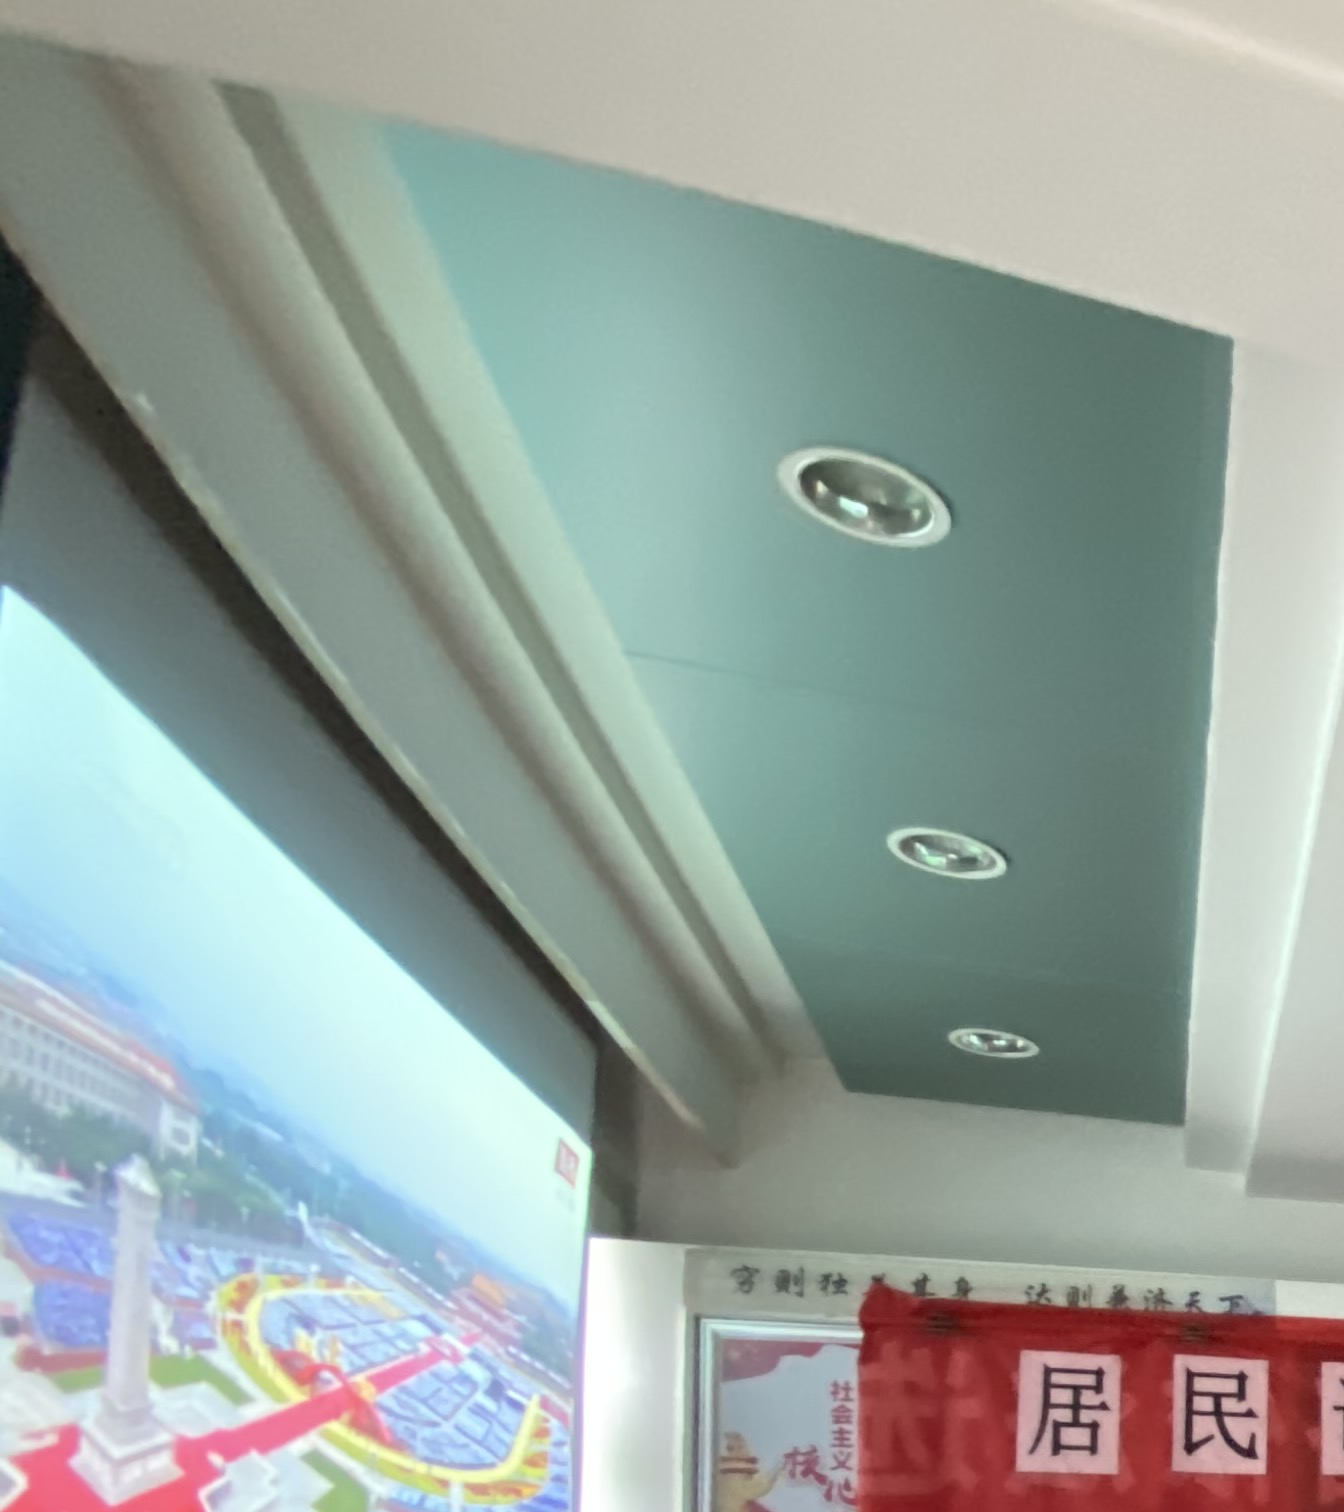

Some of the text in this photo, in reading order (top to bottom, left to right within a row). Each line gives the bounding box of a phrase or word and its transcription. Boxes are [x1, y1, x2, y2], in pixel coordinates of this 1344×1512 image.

[730, 1265, 974, 1299] 穷则独其身
